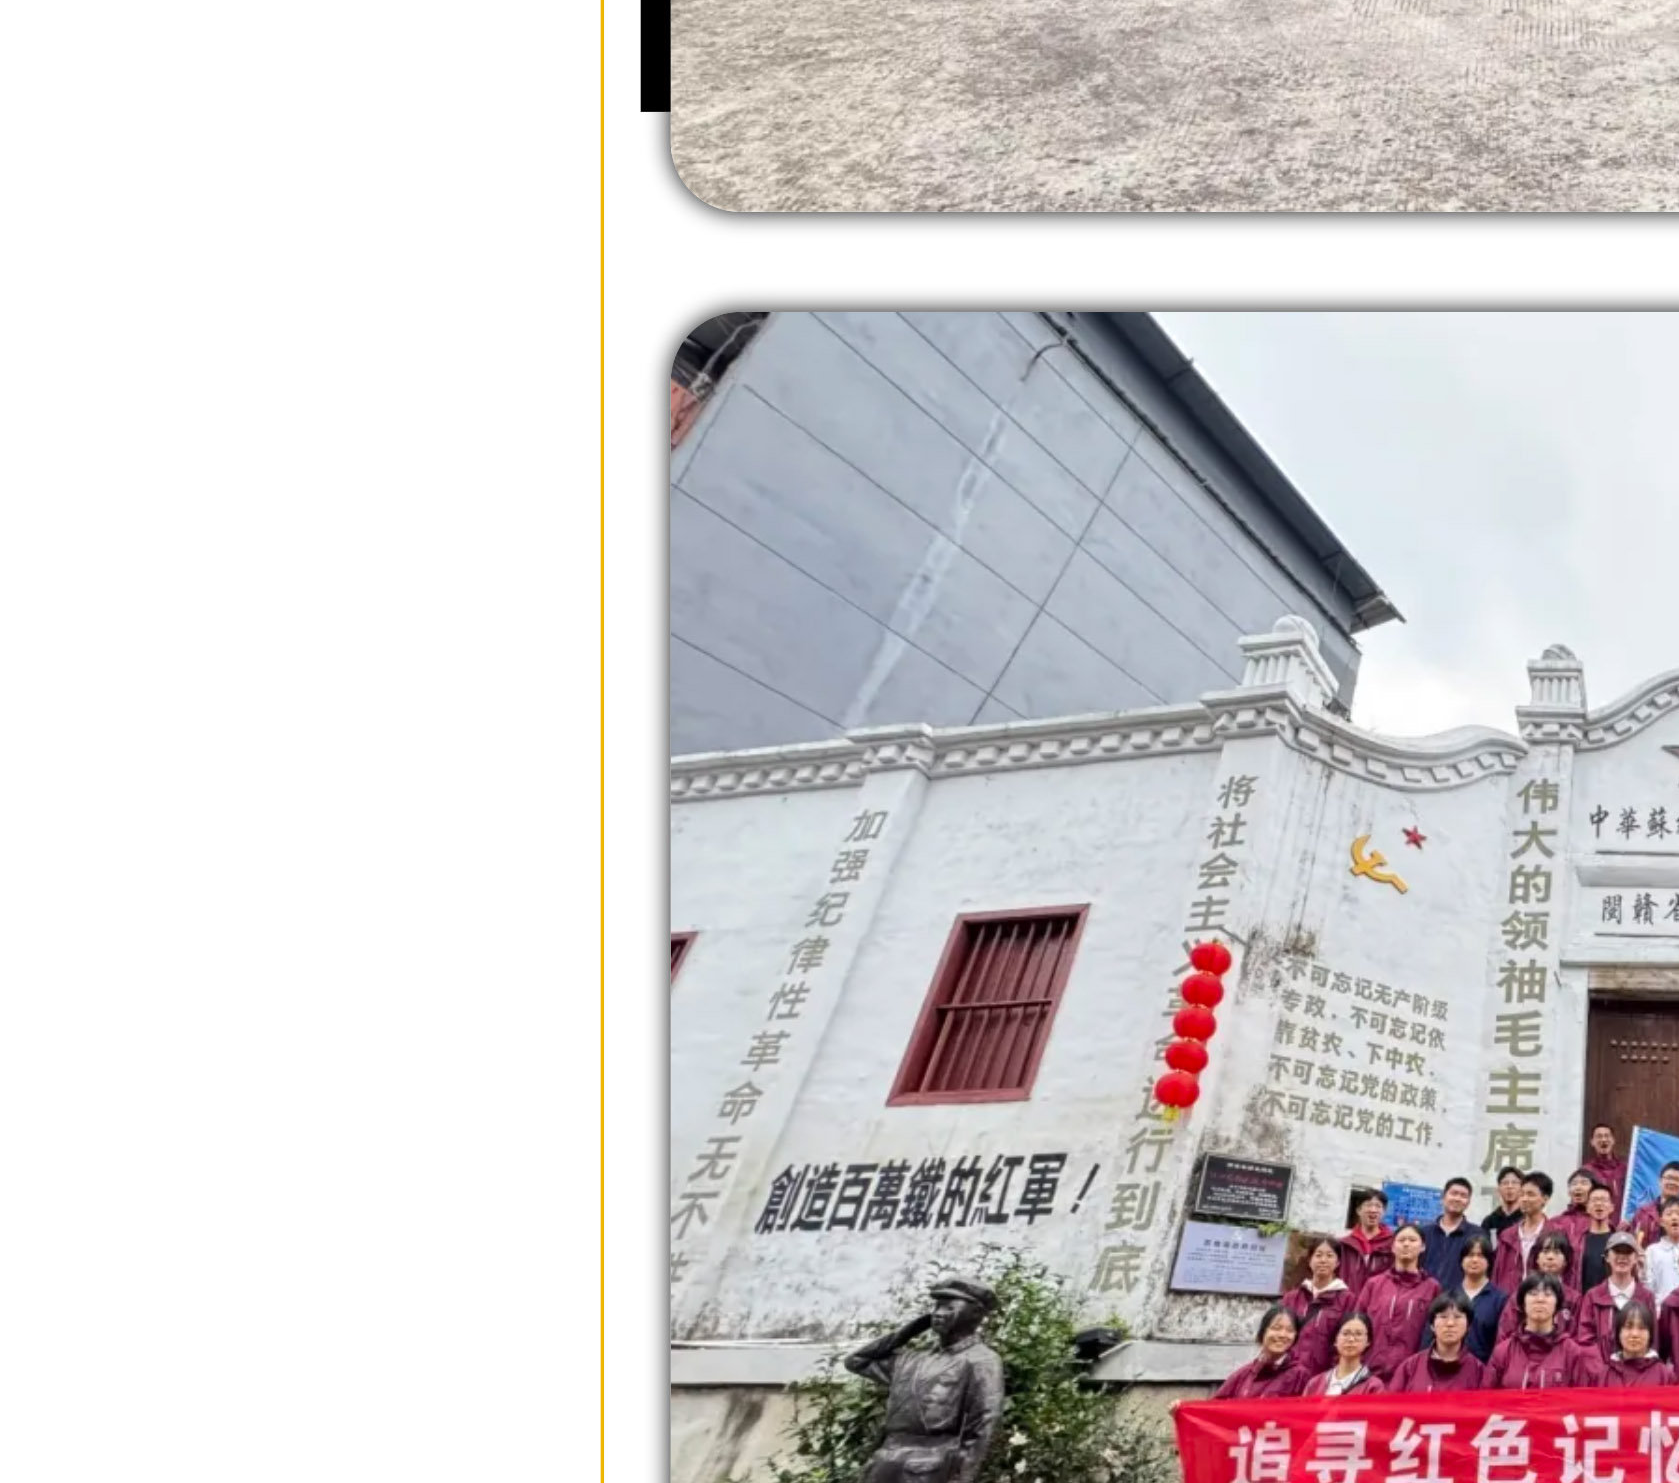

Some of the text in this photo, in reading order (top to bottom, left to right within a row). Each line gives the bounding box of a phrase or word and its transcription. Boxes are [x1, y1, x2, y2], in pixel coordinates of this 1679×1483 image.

[1286, 957, 1449, 1021] 不可忘记无产阶级
